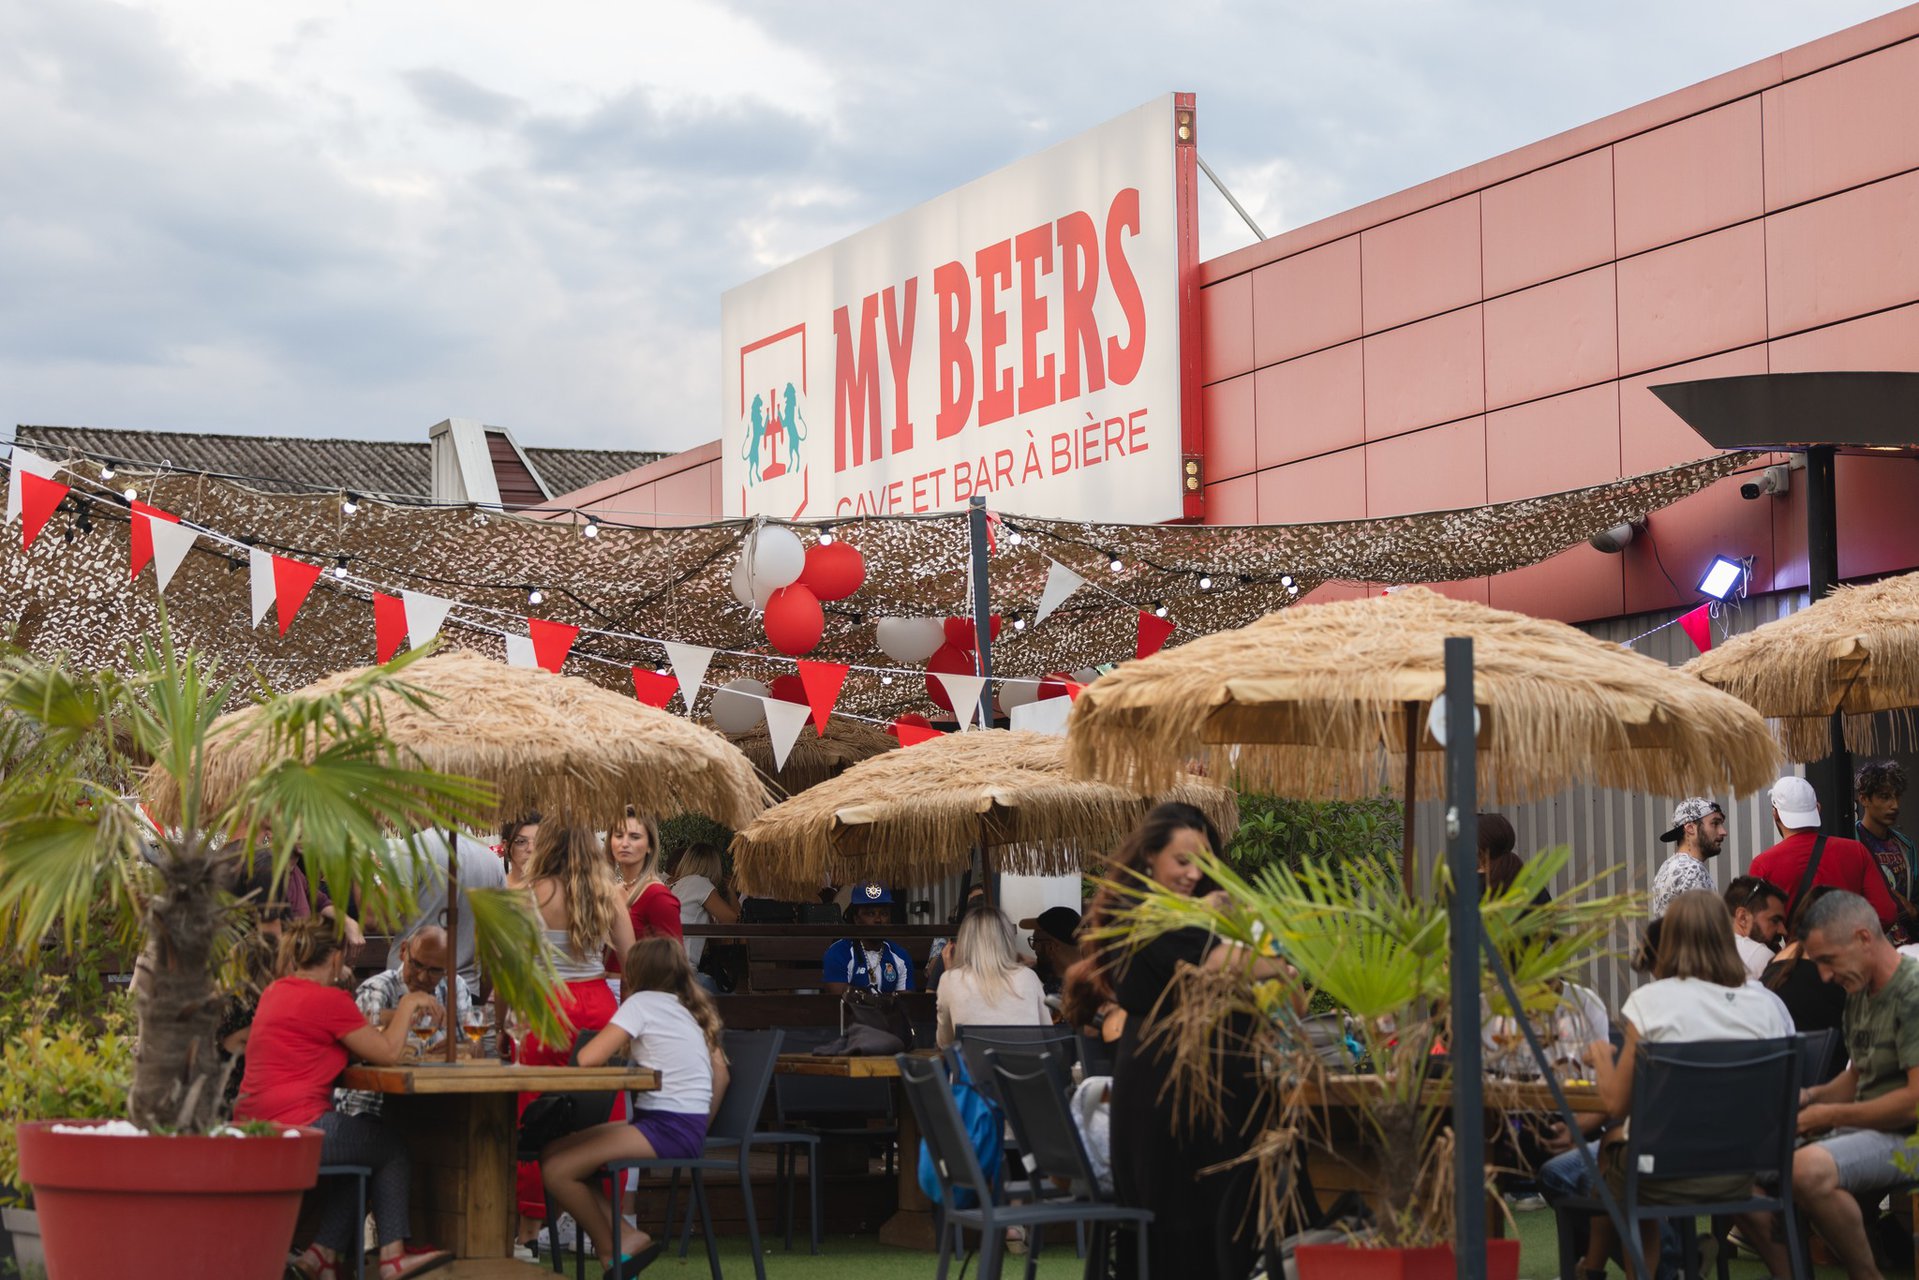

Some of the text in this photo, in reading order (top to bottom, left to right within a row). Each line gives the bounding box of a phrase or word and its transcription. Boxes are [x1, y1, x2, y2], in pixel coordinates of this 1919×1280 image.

[833, 187, 1146, 473] MY BEERS
[835, 408, 1149, 515] CAVE ET BAR À BIÈRE
